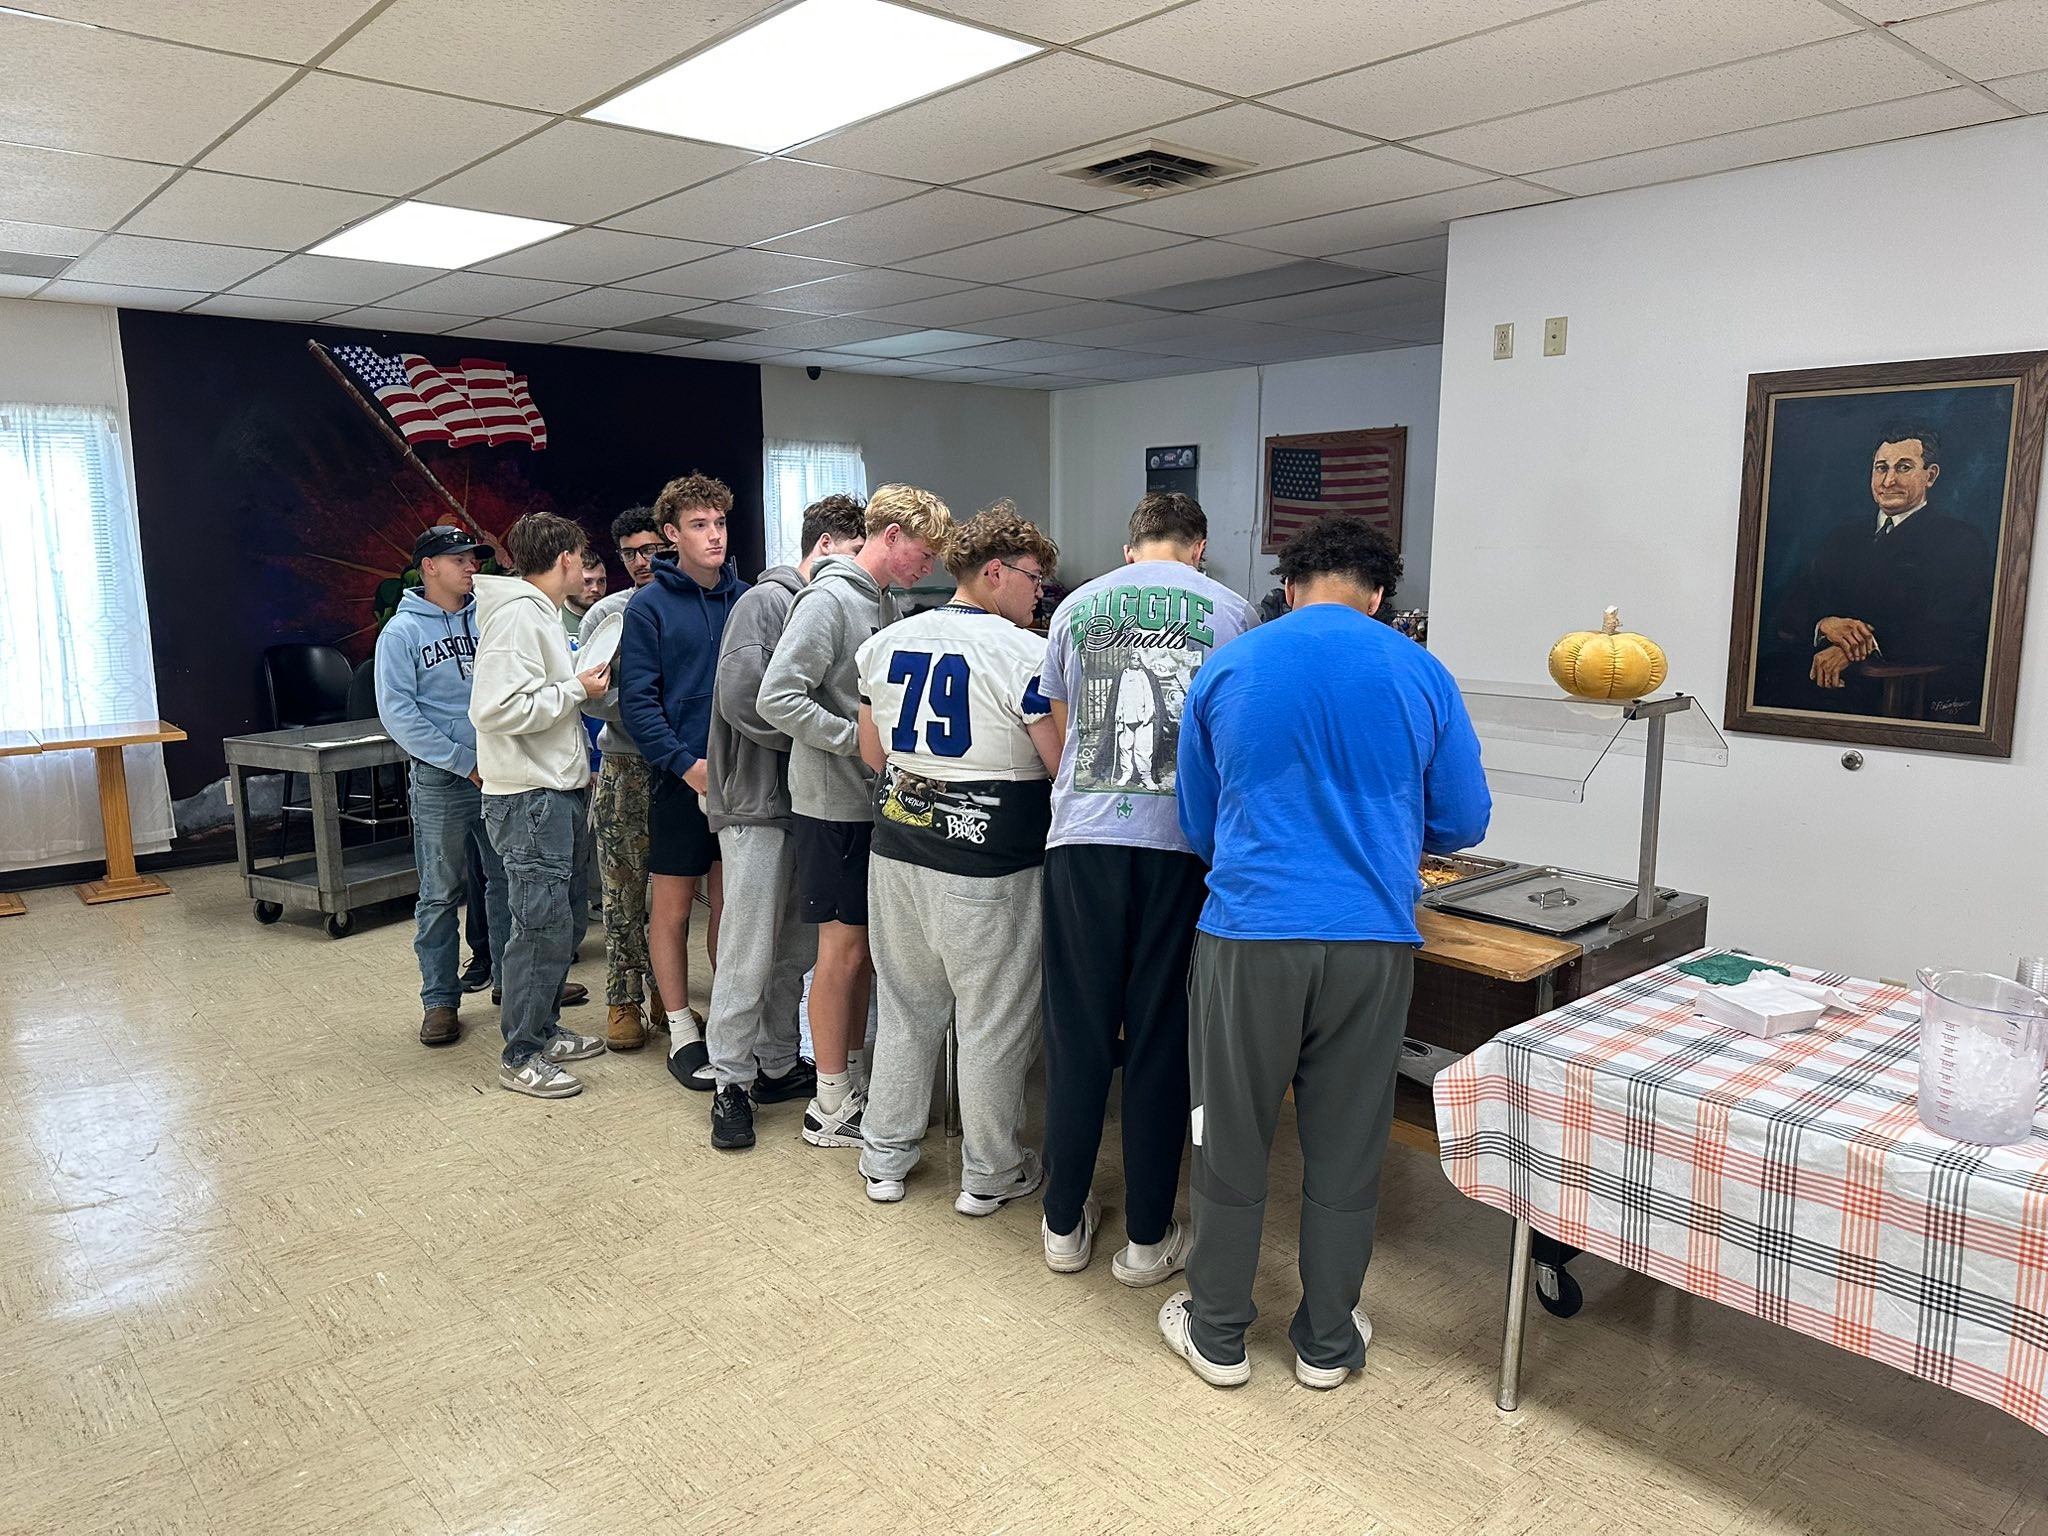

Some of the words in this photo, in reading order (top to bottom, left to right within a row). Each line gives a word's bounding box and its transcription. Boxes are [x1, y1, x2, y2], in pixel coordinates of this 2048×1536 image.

[1070, 585, 1214, 650] BIGGIE
[1085, 615, 1189, 651] Smalls
[887, 650, 973, 758] 79
